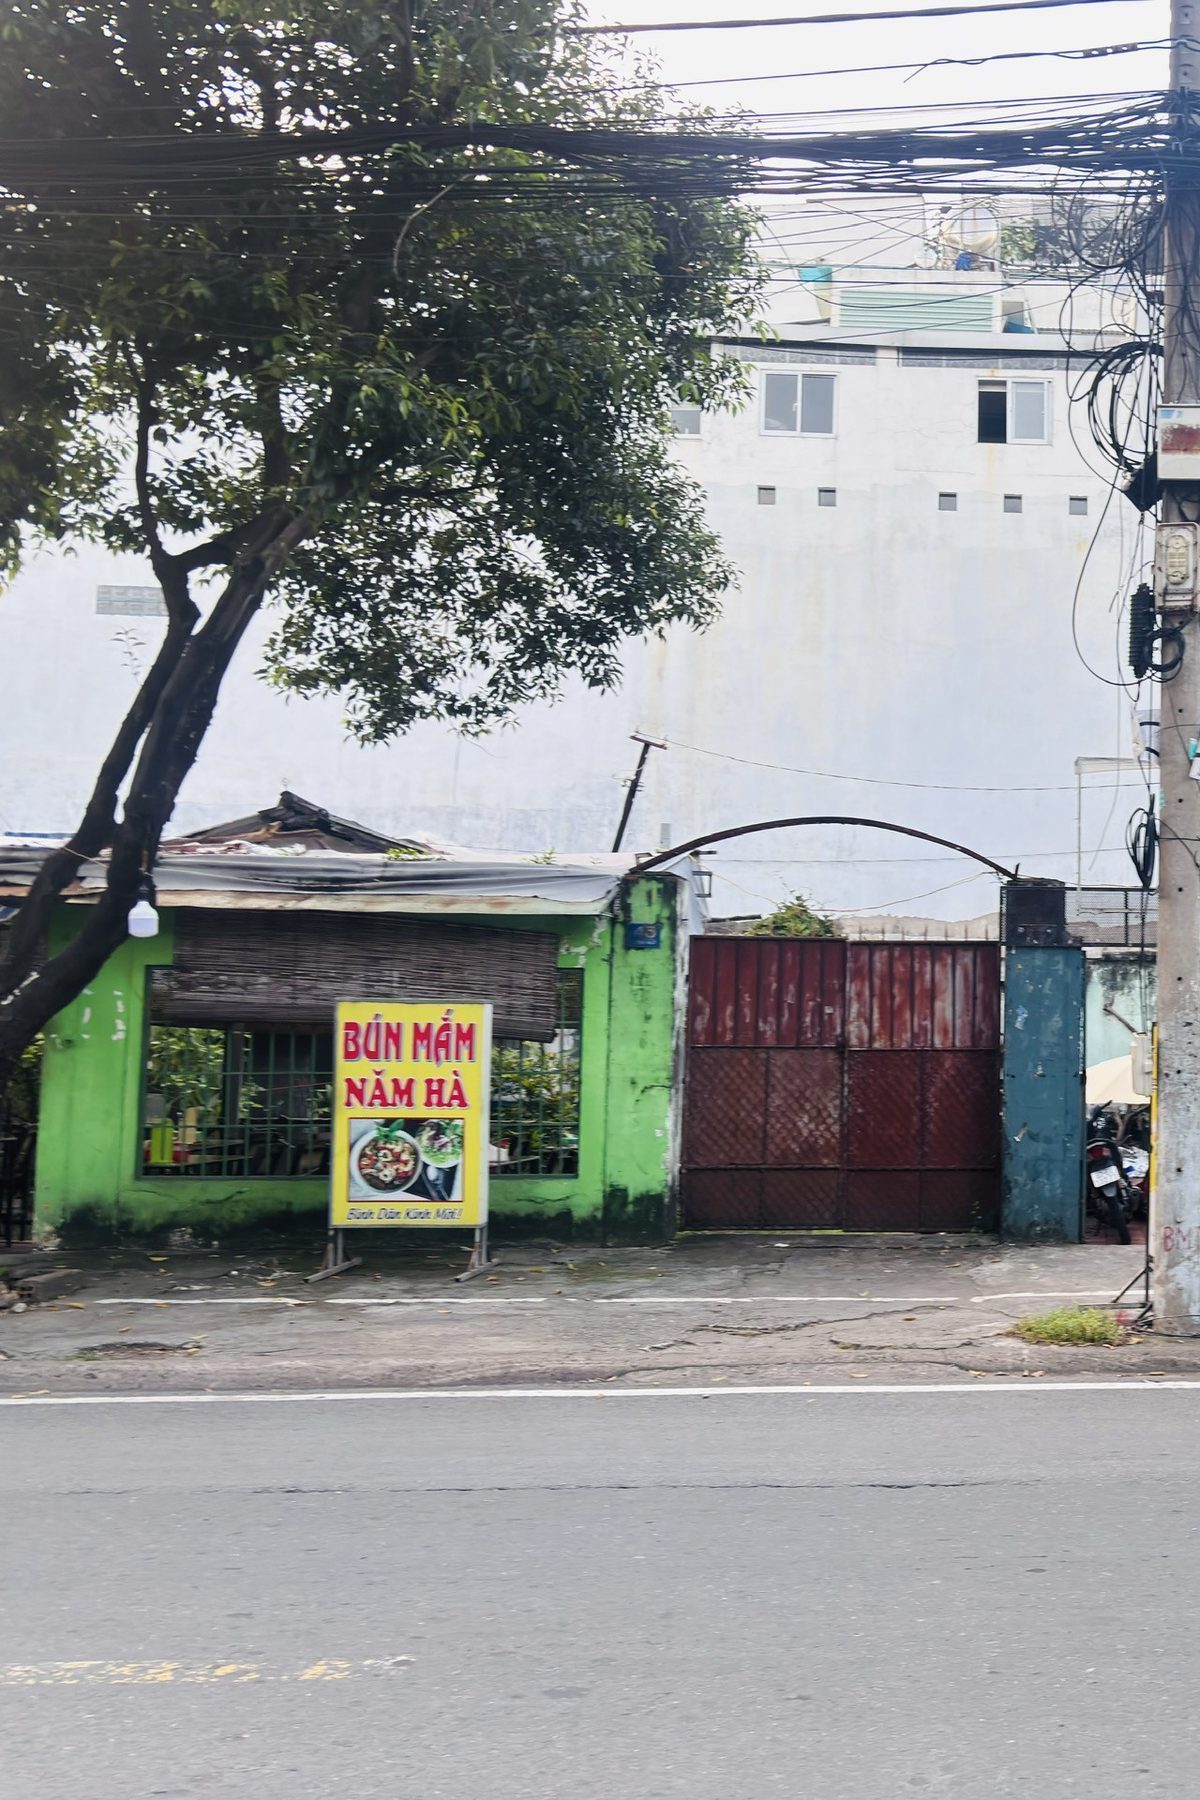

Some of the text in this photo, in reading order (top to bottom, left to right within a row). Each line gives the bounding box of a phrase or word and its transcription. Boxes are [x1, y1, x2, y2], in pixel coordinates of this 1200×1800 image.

[343, 1008, 476, 1067] BÚN MẮM
[344, 1069, 470, 1109] NĂM HÀ
